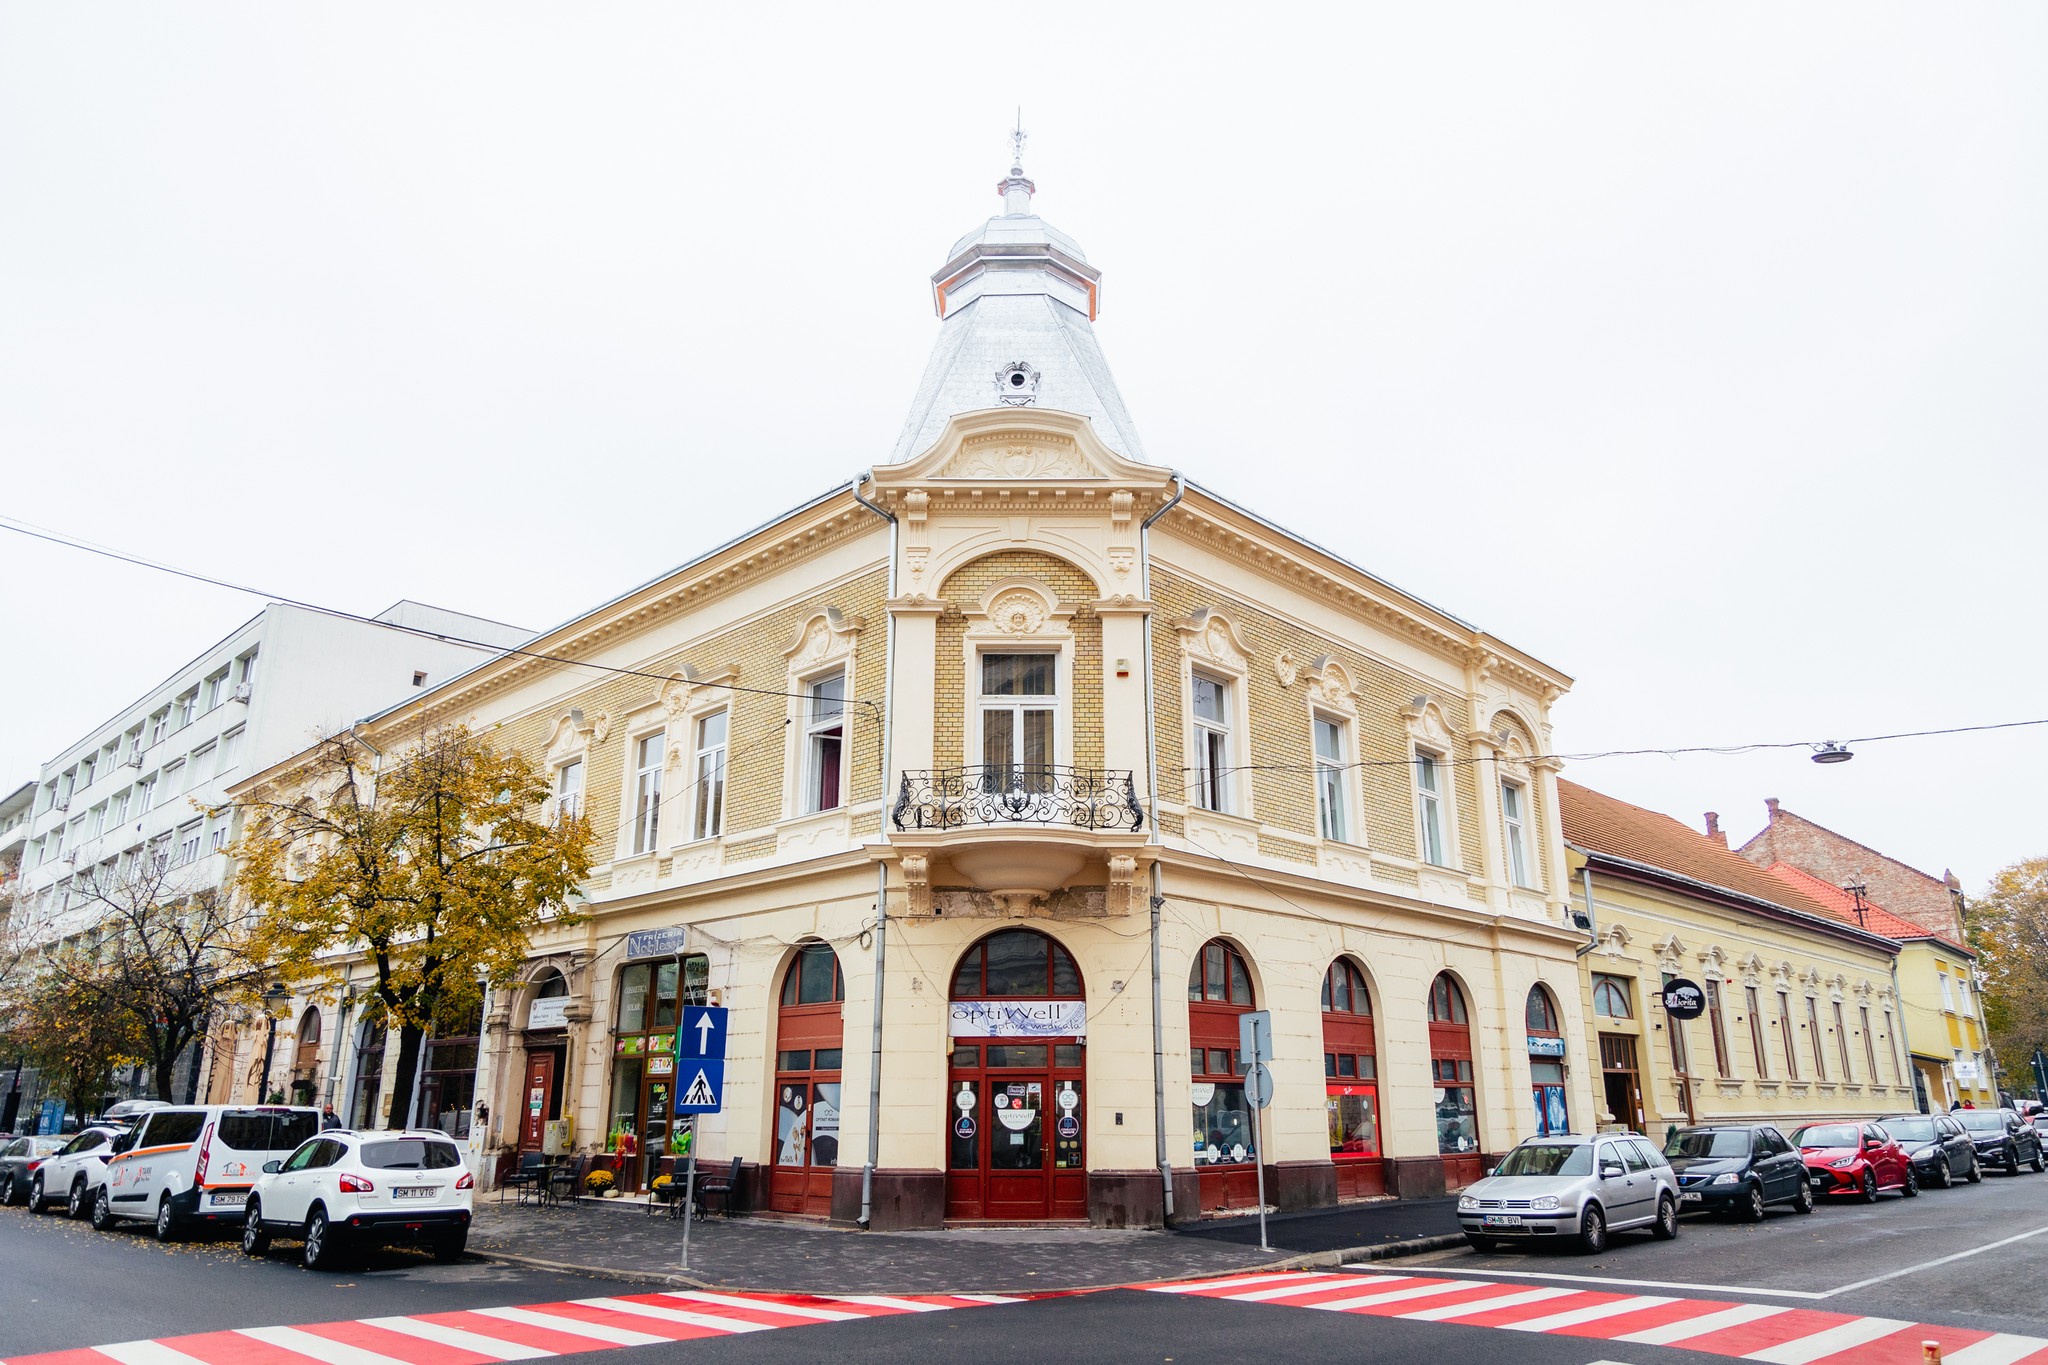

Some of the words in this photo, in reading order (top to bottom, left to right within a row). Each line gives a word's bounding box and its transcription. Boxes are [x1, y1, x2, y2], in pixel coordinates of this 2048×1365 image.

[643, 930, 683, 941] FRIZERIA
[649, 1059, 672, 1069] DETOX
[398, 1188, 409, 1198] SM
[411, 1188, 417, 1197] 11
[419, 1188, 434, 1197] VTG
